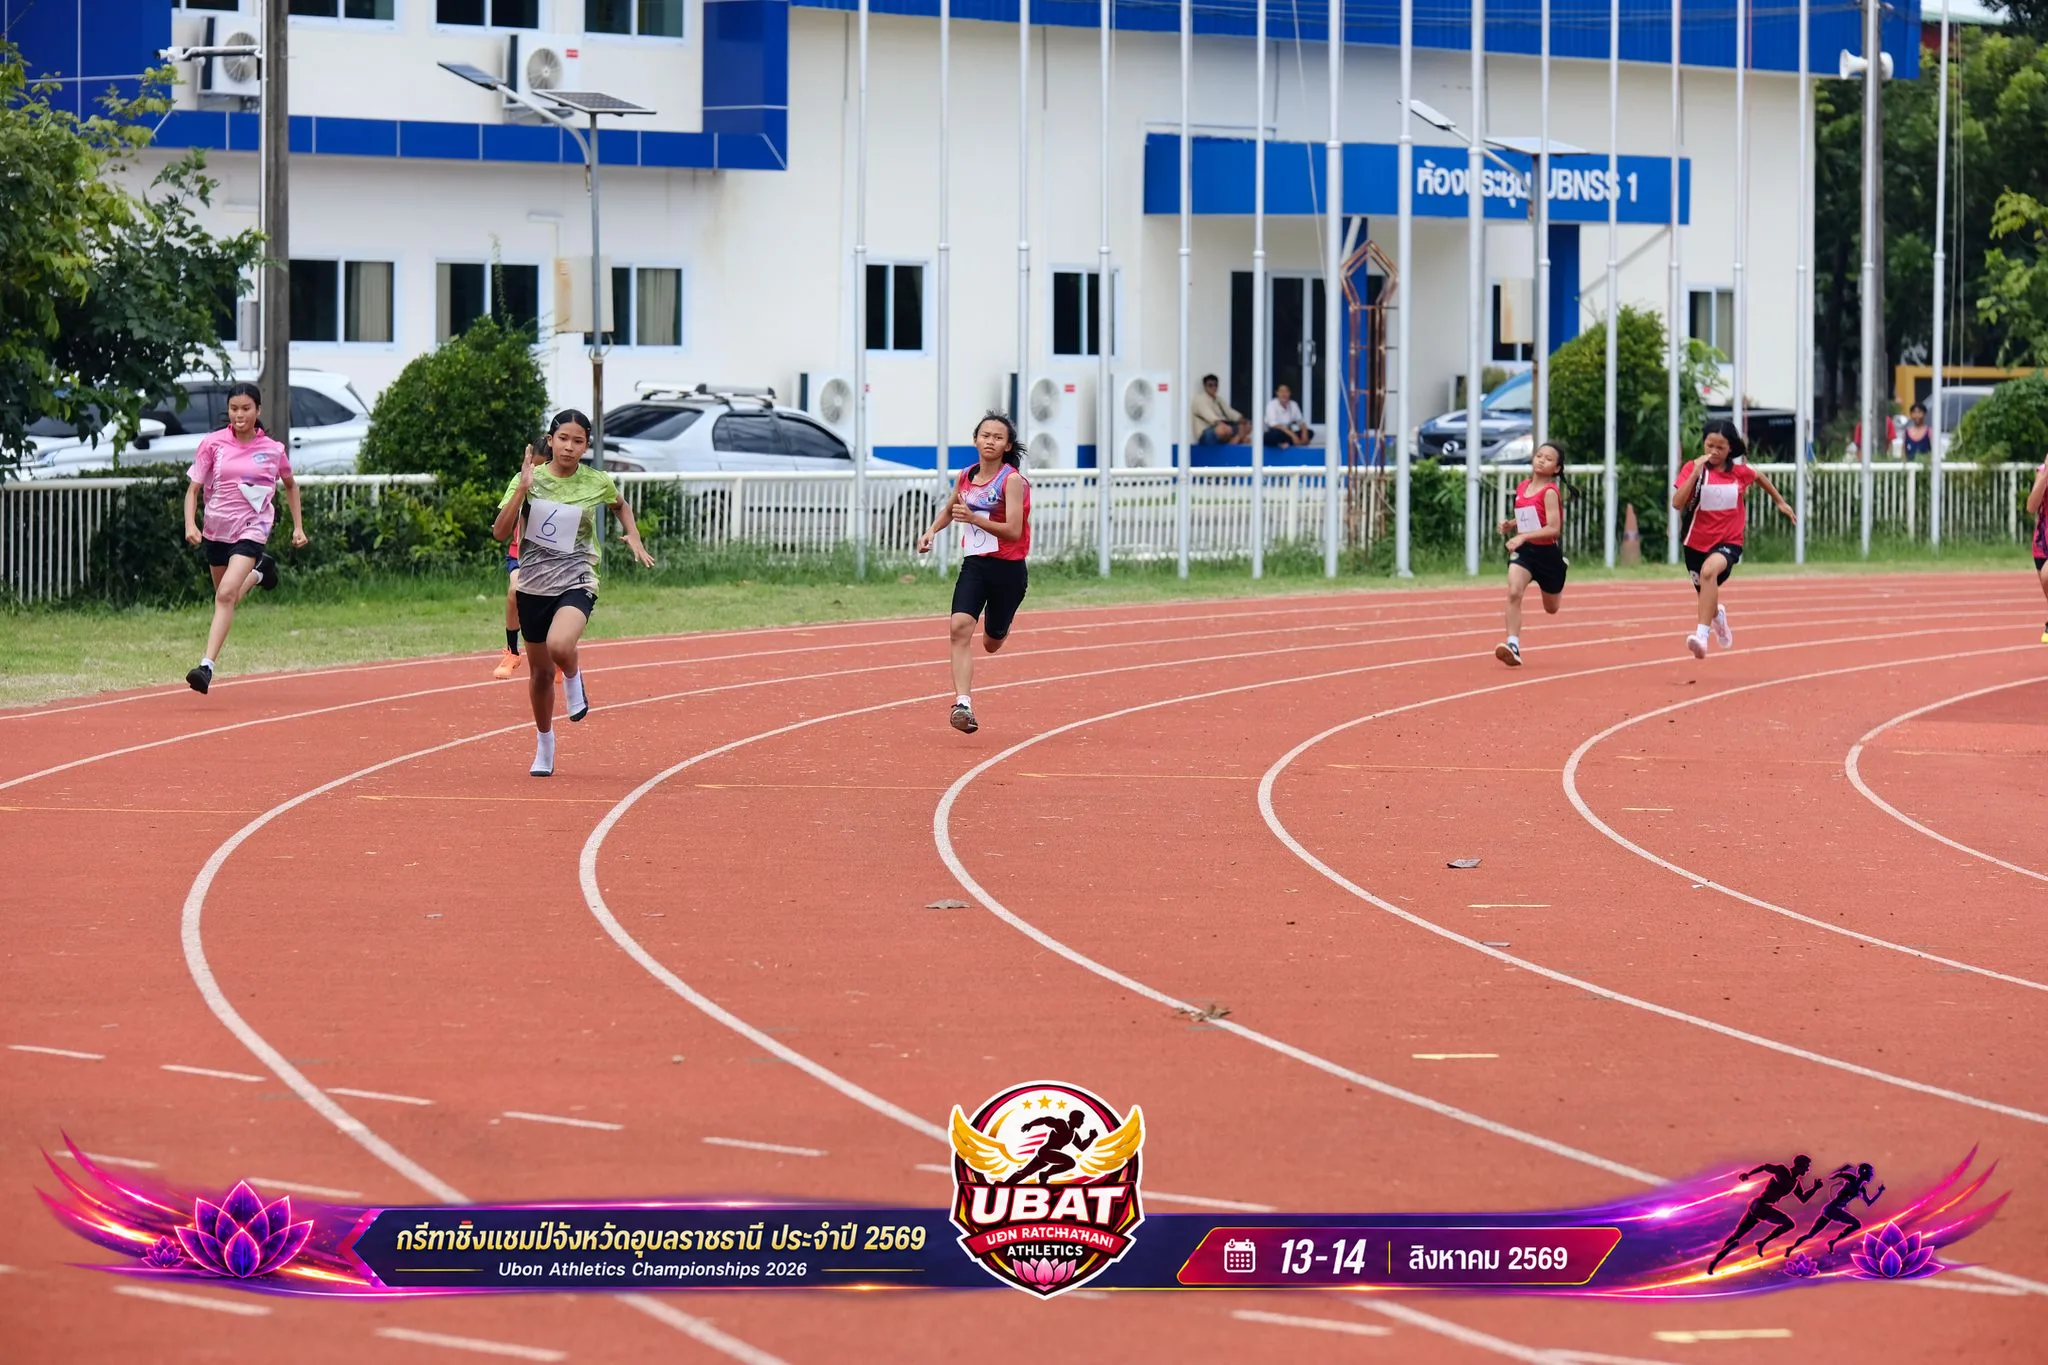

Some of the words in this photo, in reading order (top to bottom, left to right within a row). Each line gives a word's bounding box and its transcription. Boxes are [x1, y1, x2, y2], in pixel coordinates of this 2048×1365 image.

[1416, 159, 1532, 208] ห้องระชุม
[1626, 171, 1638, 203] 1
[541, 509, 558, 537] 6
[1520, 510, 1530, 528] 4
